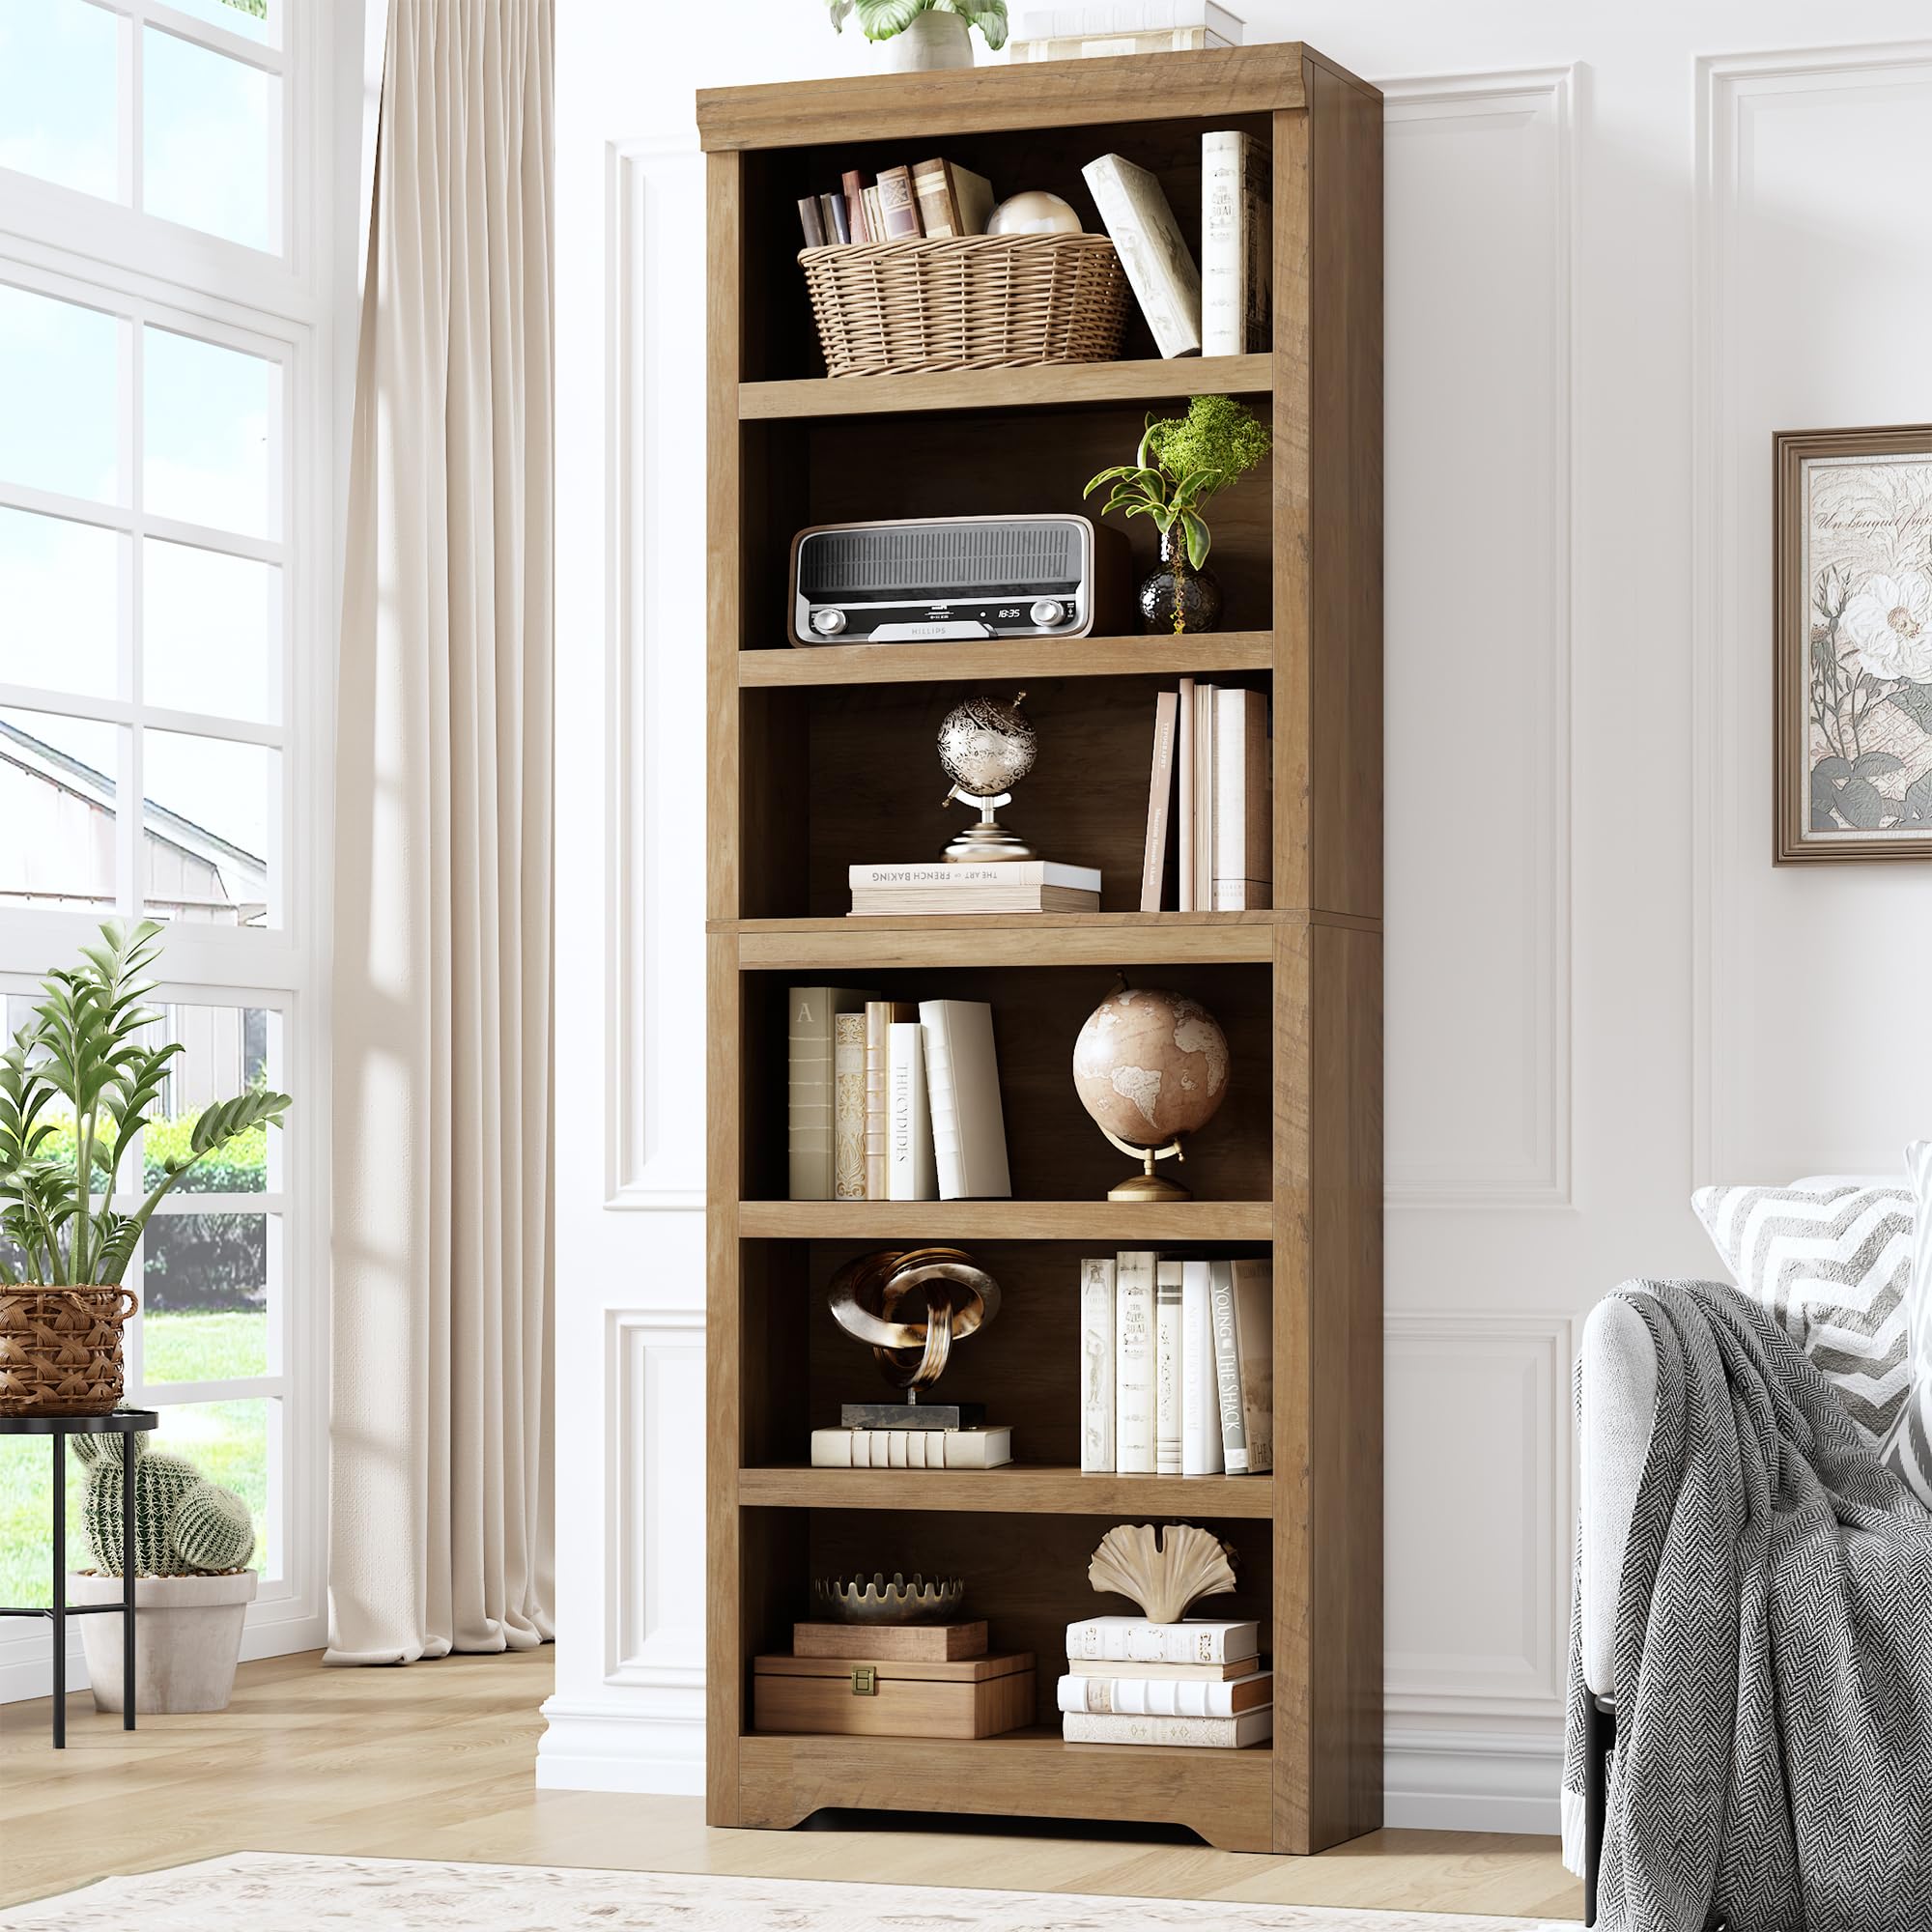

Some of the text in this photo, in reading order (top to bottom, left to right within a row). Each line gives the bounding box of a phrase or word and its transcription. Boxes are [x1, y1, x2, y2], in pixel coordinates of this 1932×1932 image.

[998, 609, 1020, 618] 18:35
[912, 627, 947, 636] HILLIPS
[872, 872, 911, 882] BAKING
[913, 871, 951, 880] FRENCH
[796, 1003, 815, 1023] A
[1215, 1286, 1239, 1431] YOUNG THE SHACK
[1251, 1441, 1267, 1464] THE
